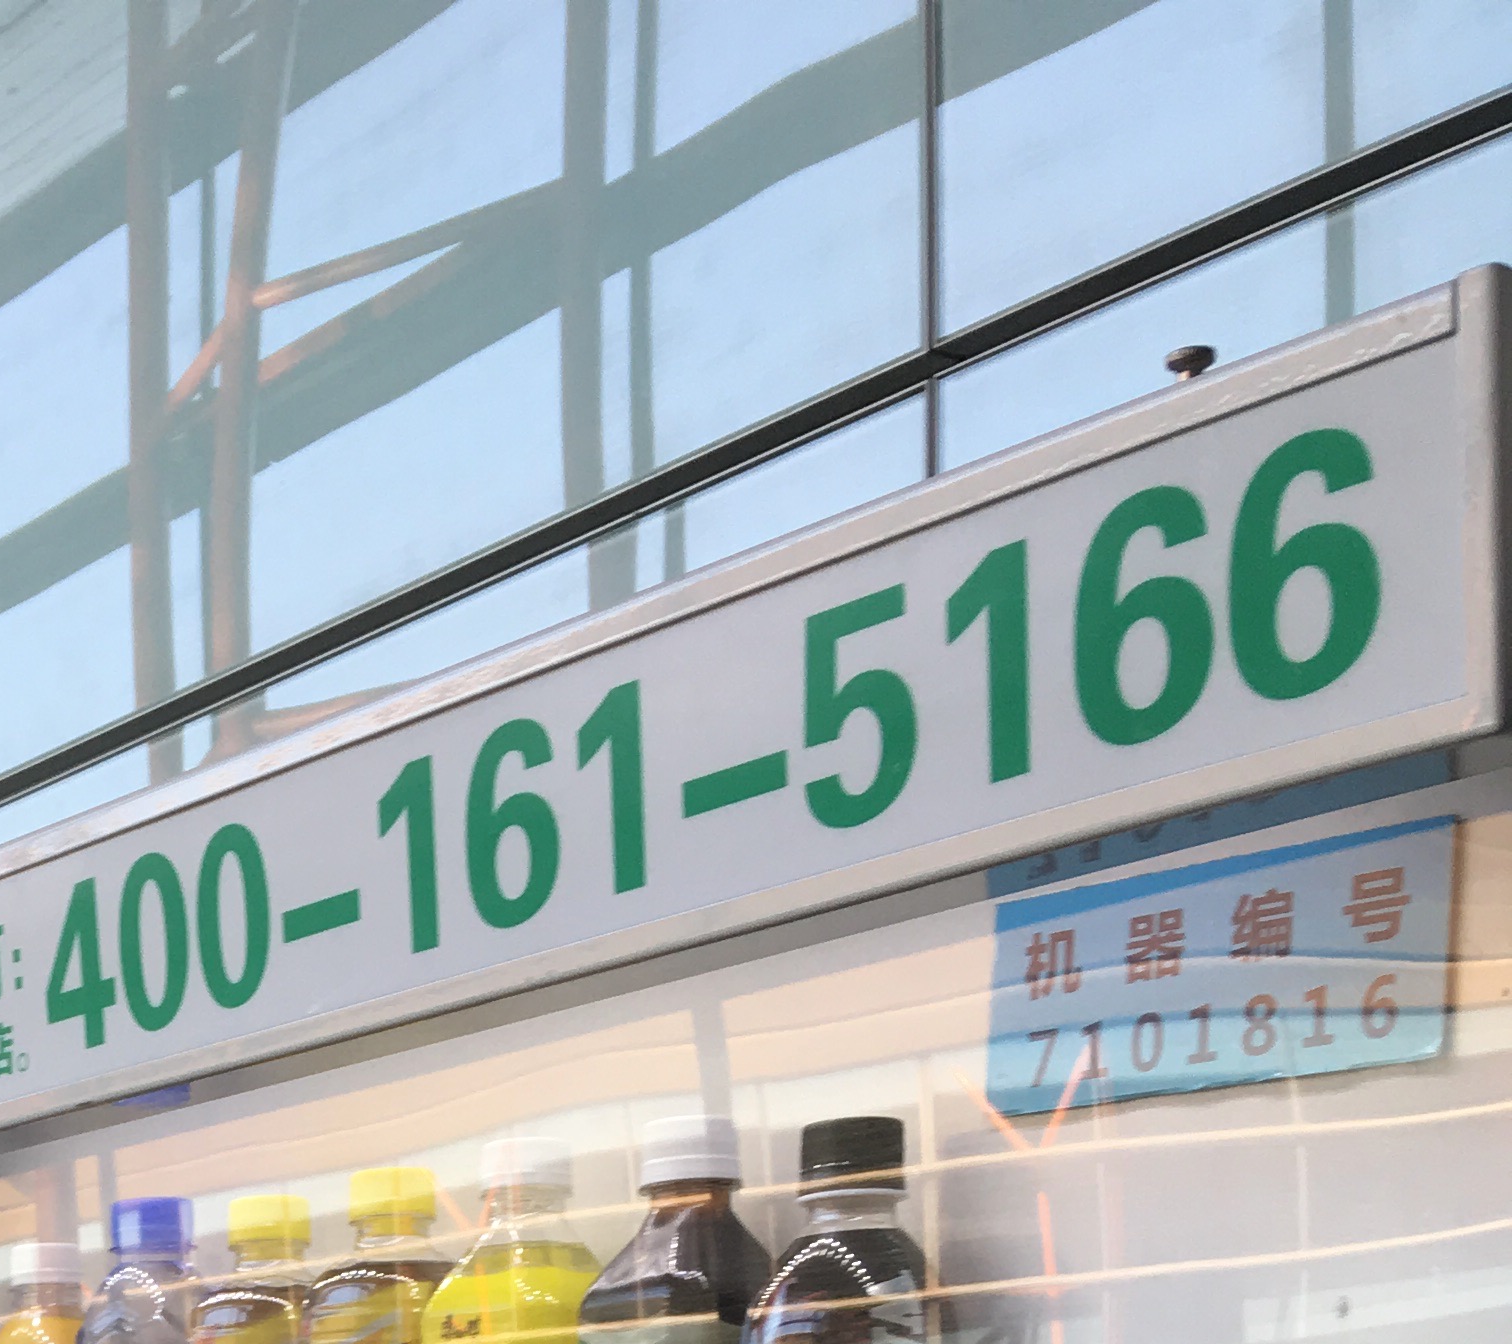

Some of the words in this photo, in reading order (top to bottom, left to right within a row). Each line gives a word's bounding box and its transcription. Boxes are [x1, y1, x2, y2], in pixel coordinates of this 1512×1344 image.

[43, 426, 1383, 1054] 400-161-5166
[1024, 866, 1412, 1001] 机器编号
[1025, 974, 1399, 1088] 7101816
